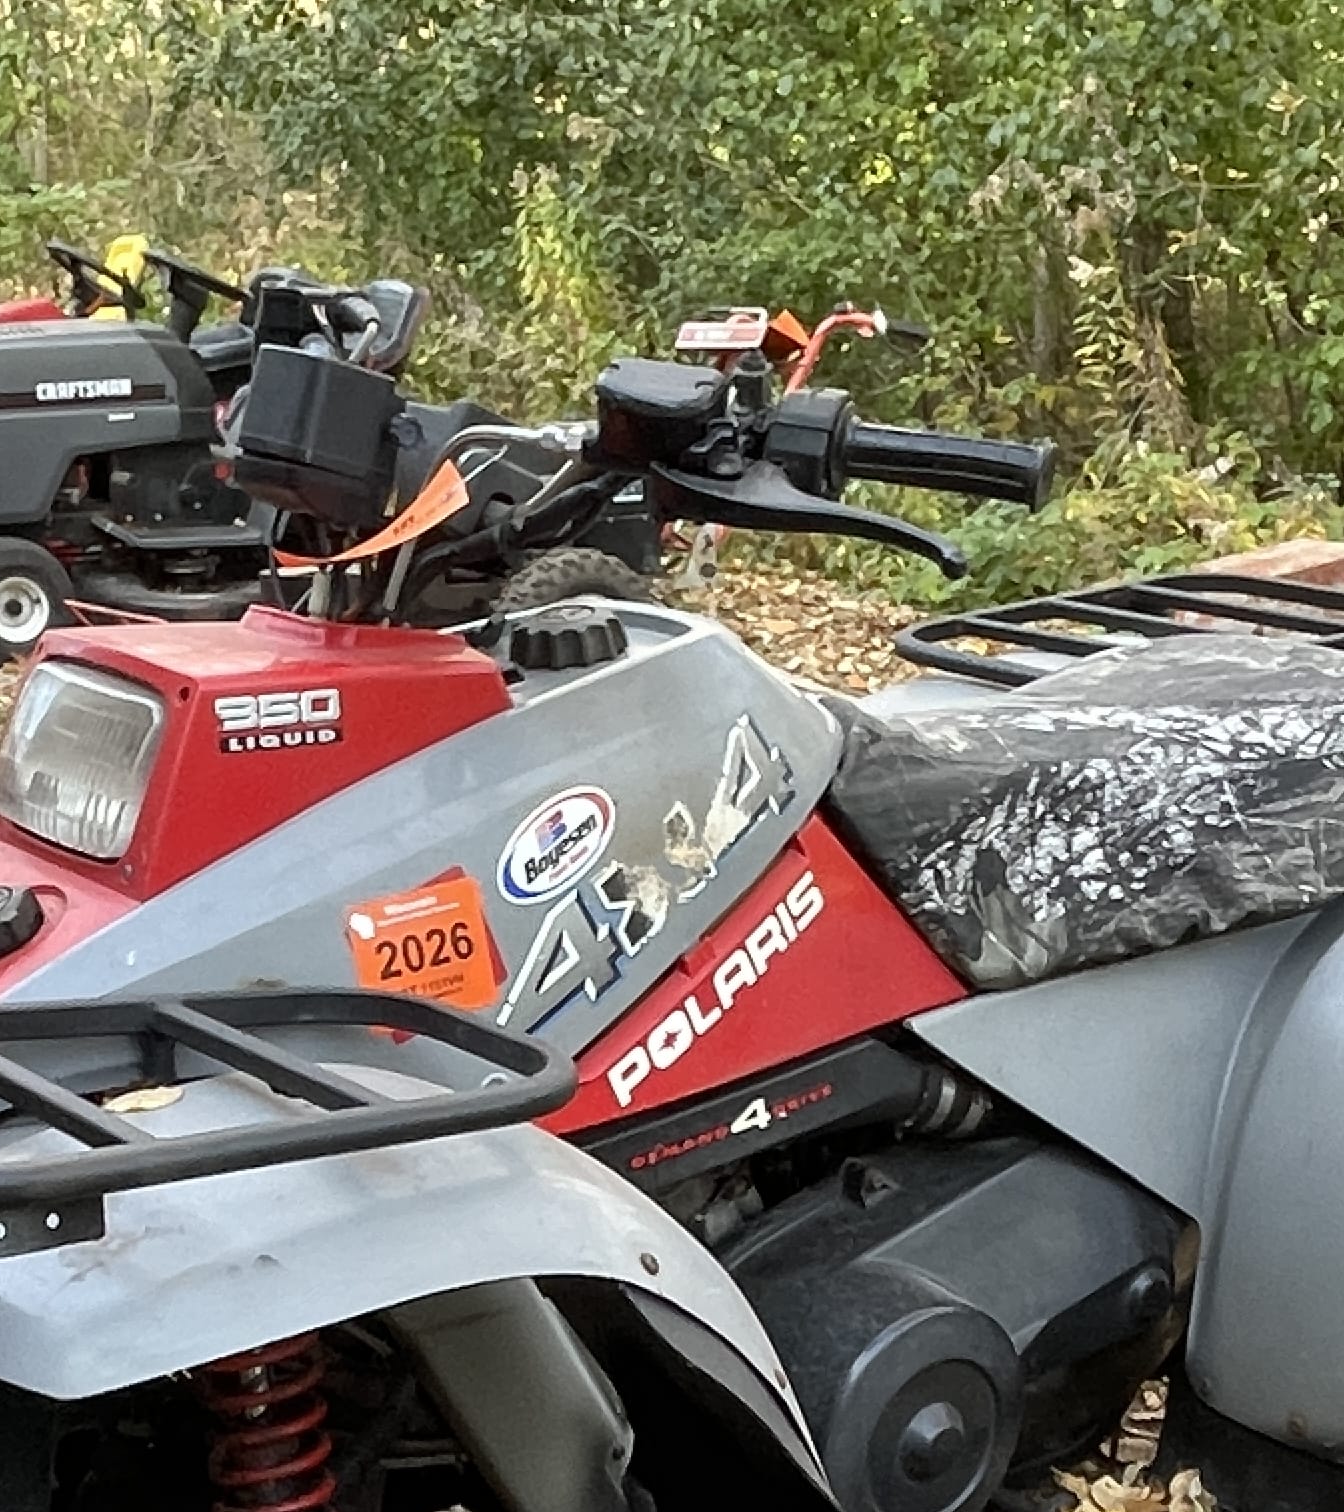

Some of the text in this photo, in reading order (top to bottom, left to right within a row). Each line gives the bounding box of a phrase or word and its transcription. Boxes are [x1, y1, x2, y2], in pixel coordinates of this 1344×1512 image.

[35, 378, 132, 402] CRAFTSMAN
[214, 689, 341, 731] 350
[228, 729, 337, 752] LIQUID
[524, 814, 597, 884] Boyesen
[374, 922, 474, 981] 2026
[607, 870, 825, 1108] POLARIS
[730, 1096, 772, 1134] 4
